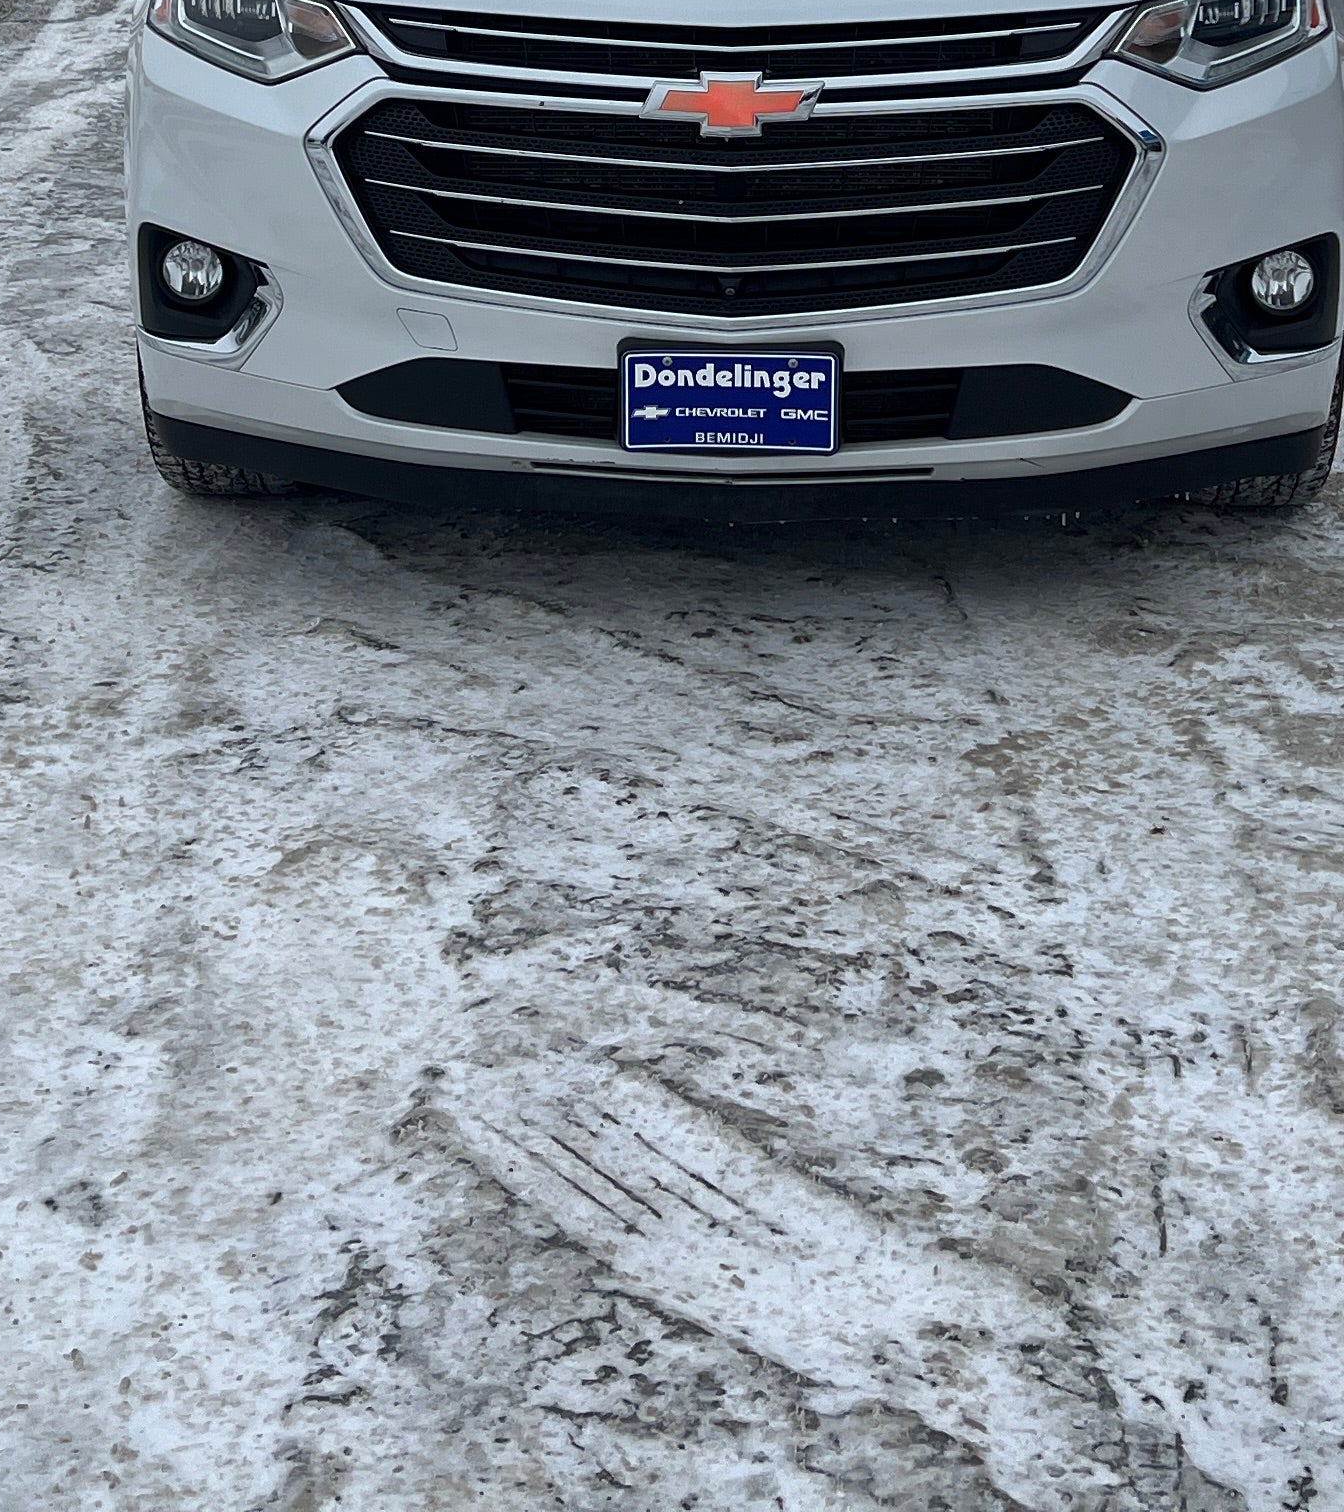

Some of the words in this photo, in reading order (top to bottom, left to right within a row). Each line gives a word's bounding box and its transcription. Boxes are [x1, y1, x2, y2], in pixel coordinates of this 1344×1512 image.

[634, 363, 826, 398] Dondelinger
[675, 407, 767, 418] CHEVROLET
[780, 408, 829, 421] GMC
[695, 432, 764, 444] BEMIDJI
